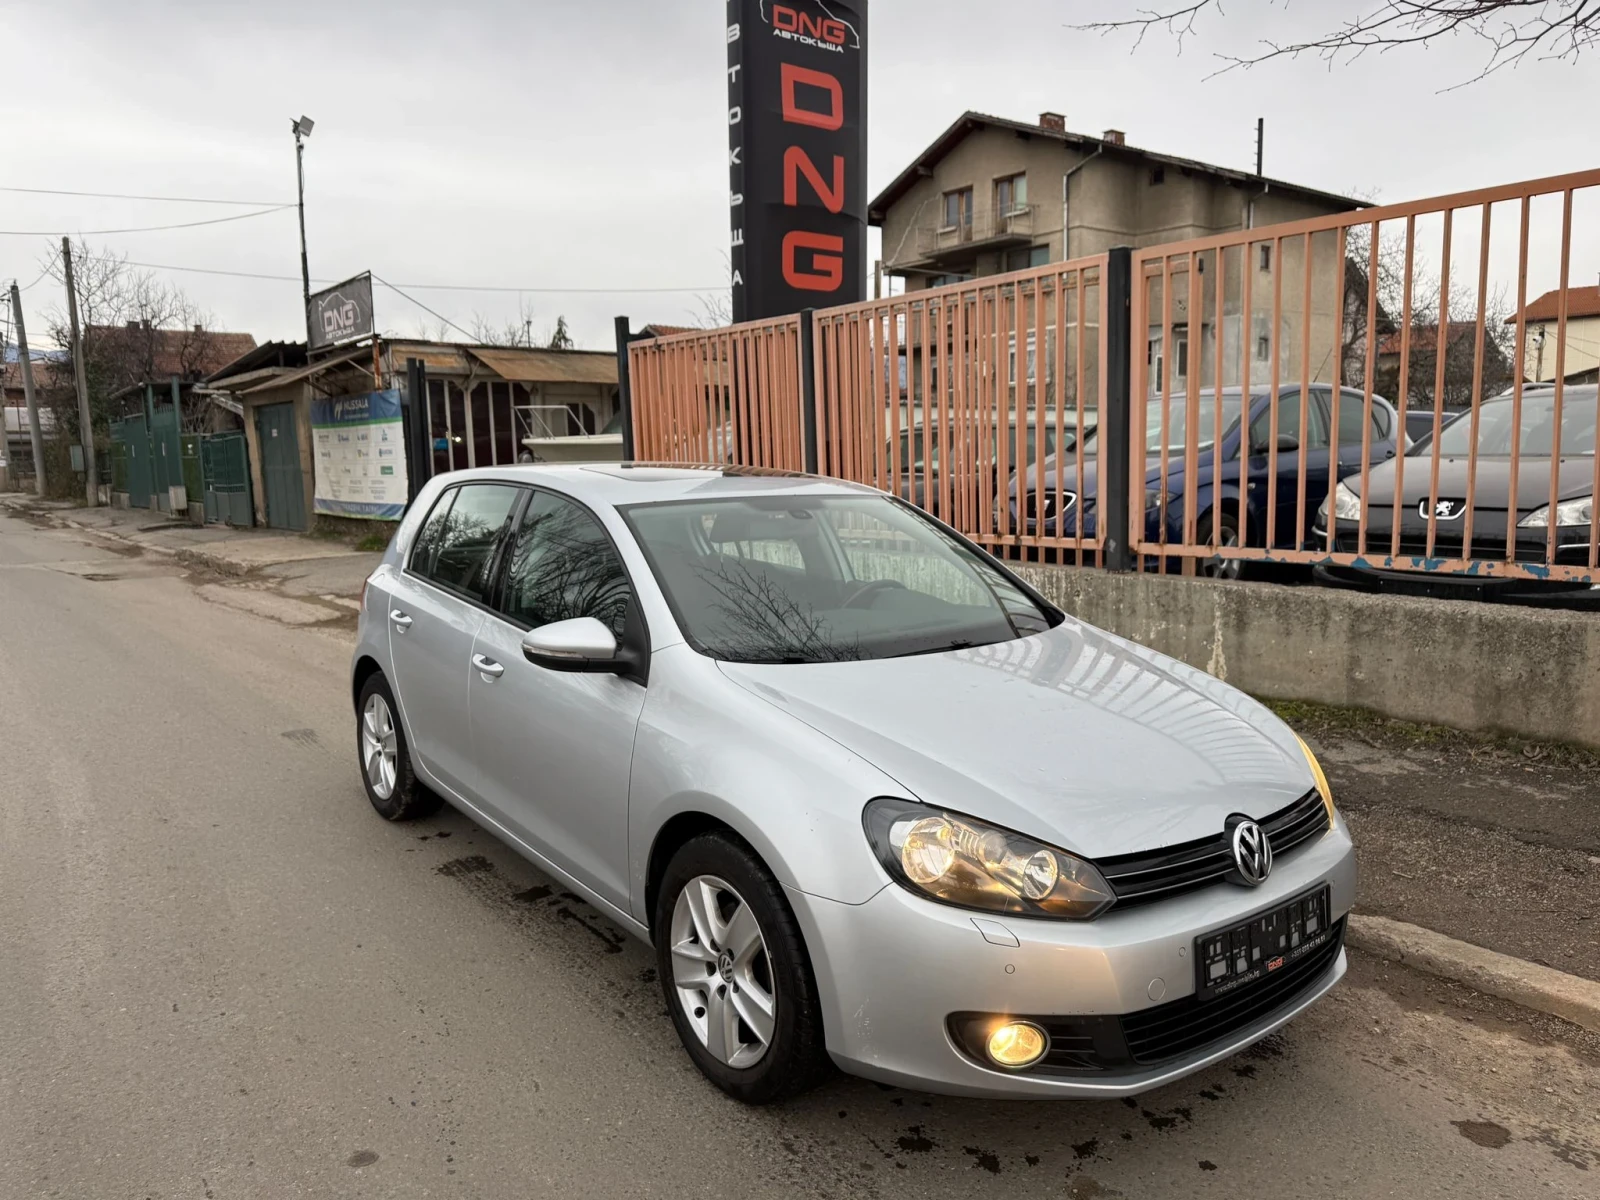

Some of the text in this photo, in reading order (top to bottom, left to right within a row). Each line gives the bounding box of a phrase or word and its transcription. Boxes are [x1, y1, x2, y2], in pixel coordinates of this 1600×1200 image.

[772, 4, 845, 45] DNG
[780, 62, 845, 292] DNG
[323, 303, 354, 332] DNG
